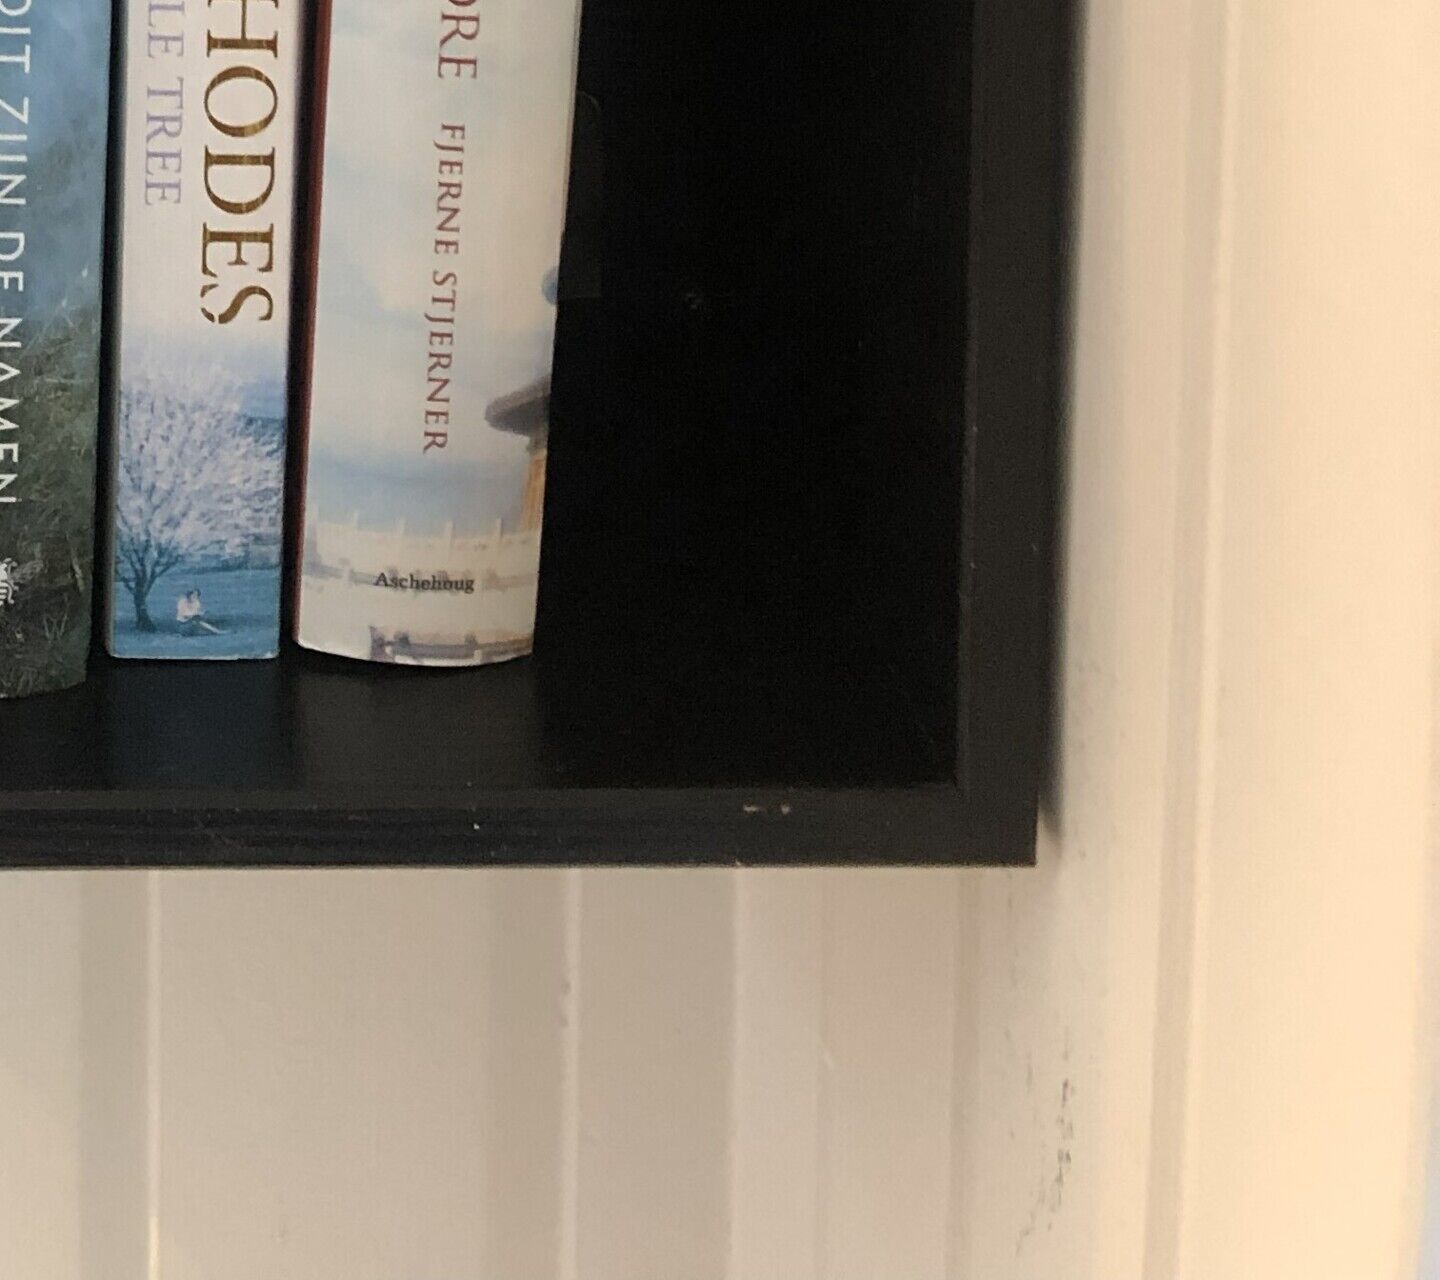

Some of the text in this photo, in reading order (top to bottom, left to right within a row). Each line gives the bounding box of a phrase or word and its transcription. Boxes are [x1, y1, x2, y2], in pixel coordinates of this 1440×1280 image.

[144, 77, 185, 207] TREE
[422, 122, 466, 455] FJERNE STJERNER
[373, 571, 475, 596] Aschehoug
